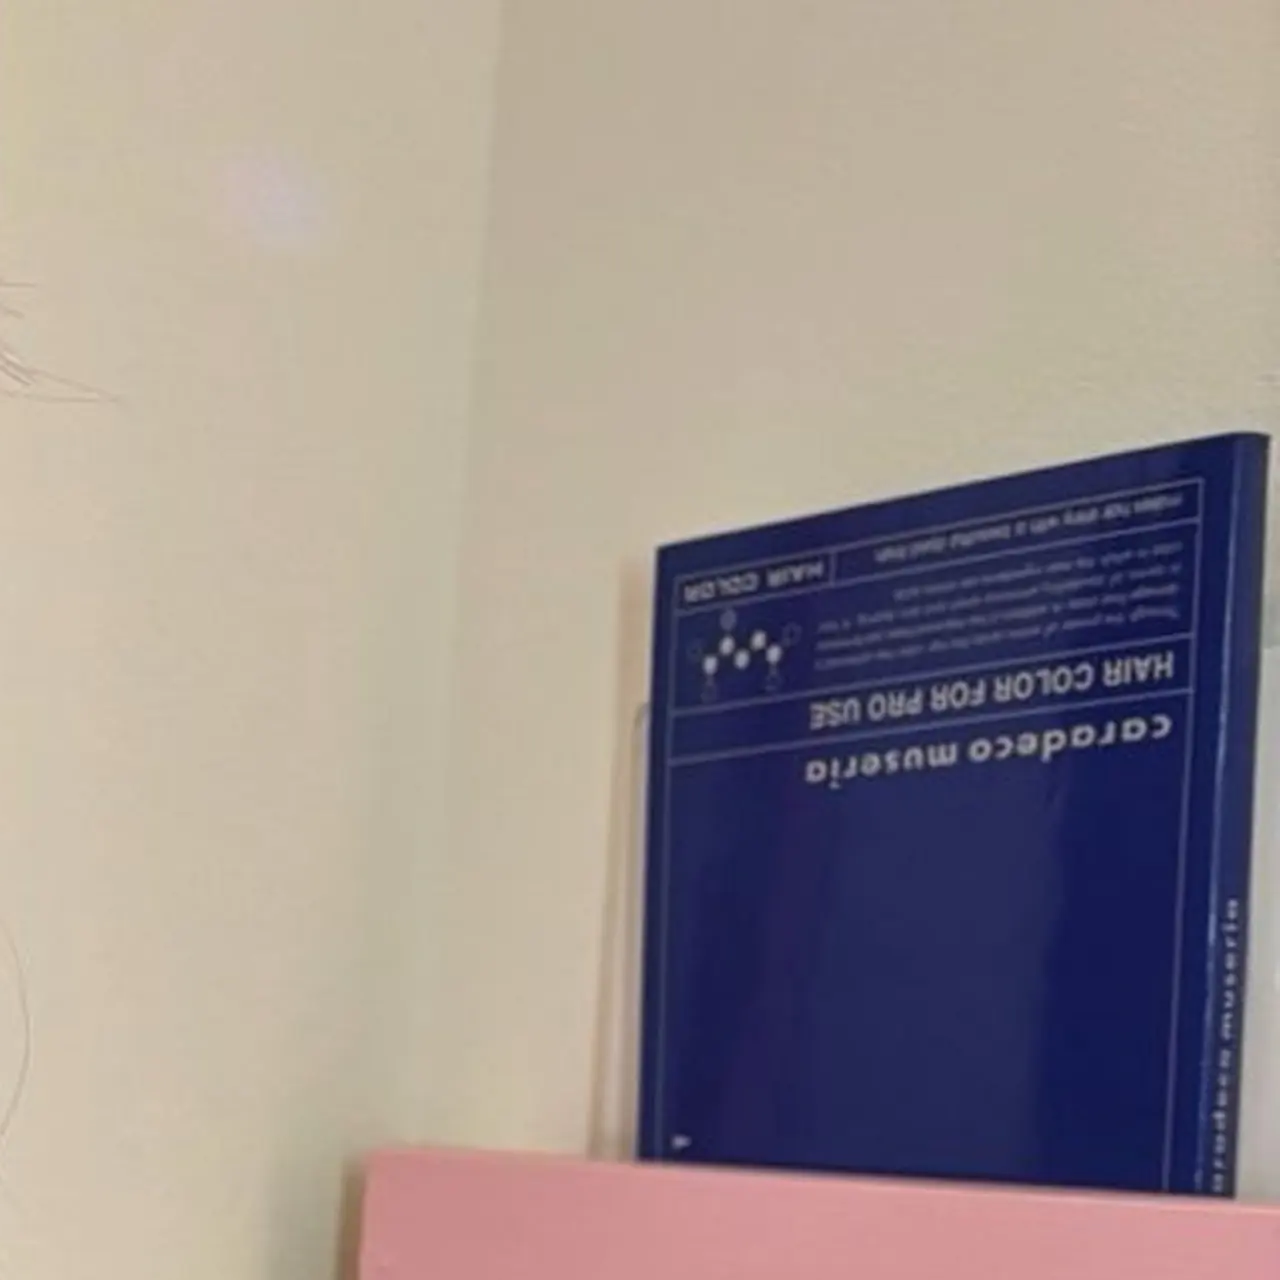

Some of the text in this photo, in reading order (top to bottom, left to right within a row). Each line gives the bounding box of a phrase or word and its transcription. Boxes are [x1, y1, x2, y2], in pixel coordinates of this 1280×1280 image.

[766, 559, 824, 588] HAIR
[809, 651, 1174, 730] HAIR COLOR FOR PRO USE
[805, 714, 1172, 789] caradeco museria
